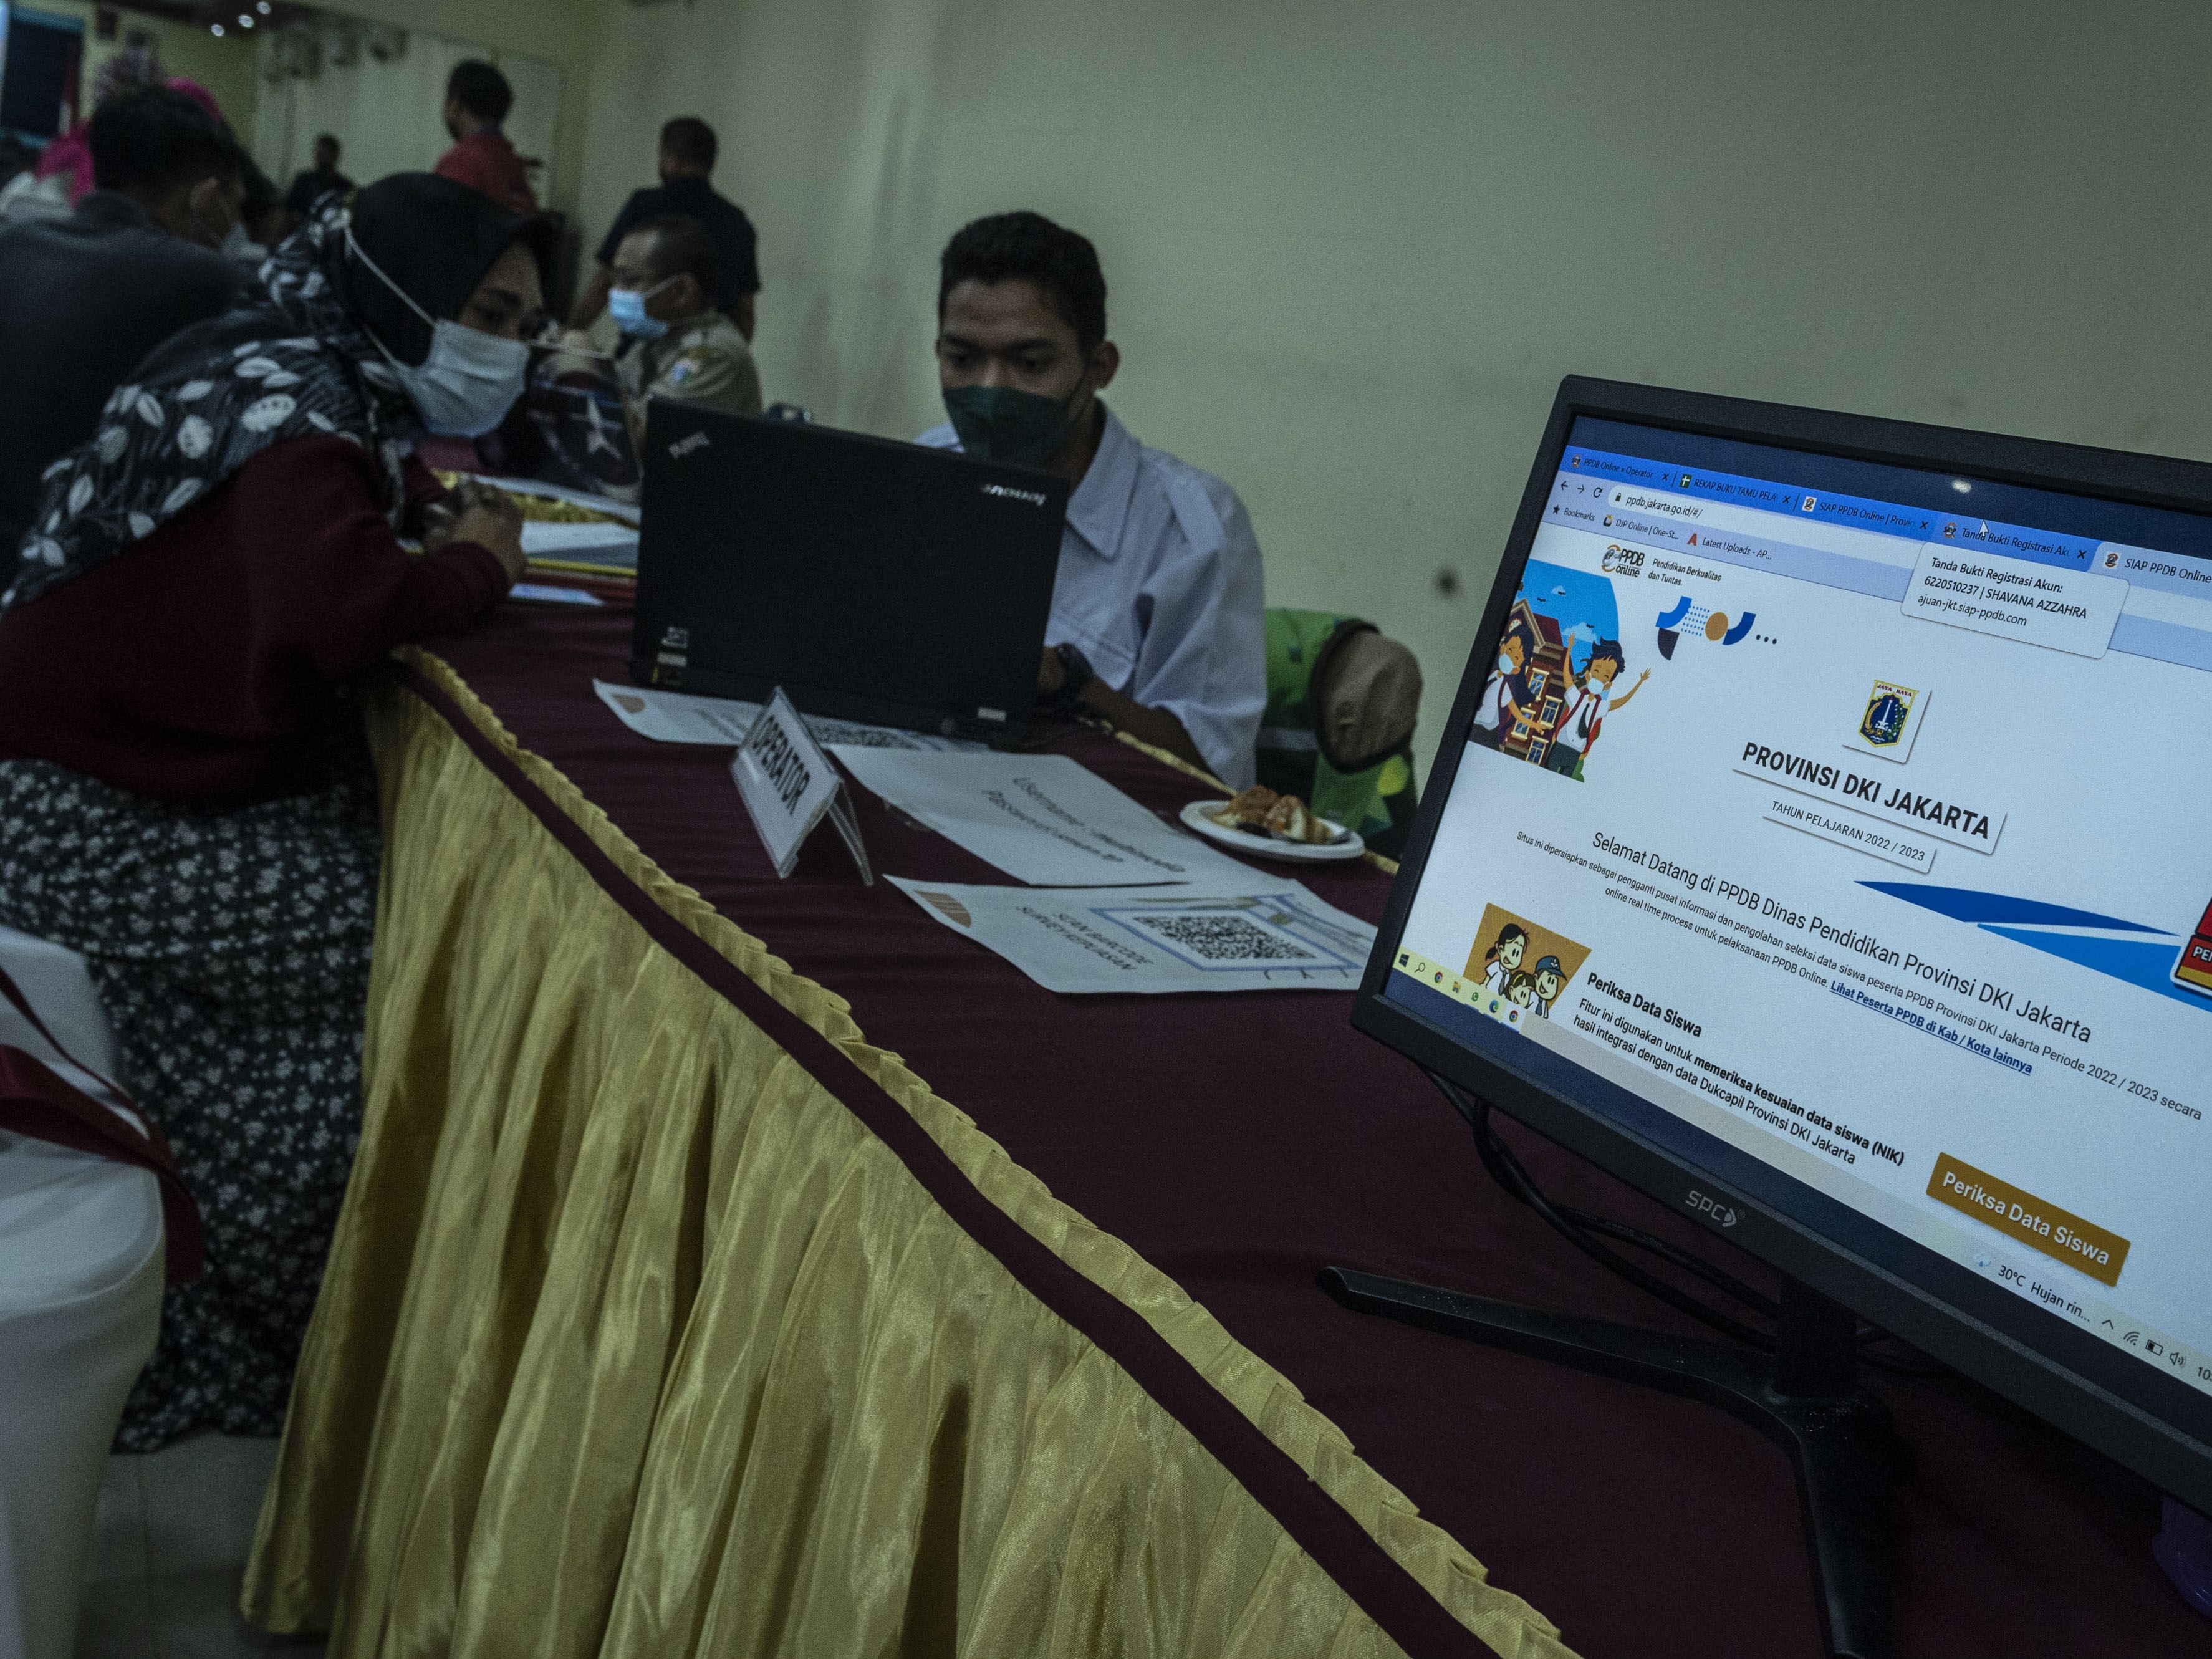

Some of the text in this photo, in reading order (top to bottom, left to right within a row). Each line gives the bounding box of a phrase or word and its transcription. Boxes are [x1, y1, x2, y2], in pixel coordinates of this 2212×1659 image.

[1583, 458, 1600, 469] PPDB
[1600, 461, 1620, 473] Online
[1625, 466, 1654, 479] Operator
[1693, 478, 1779, 502] REKAP BUKU TAMU PELA
[1564, 507, 1595, 522] Bookmarks
[1625, 496, 1703, 519] ppdb.jakarta.go.id/#/
[1819, 501, 1838, 513] SIAP
[1837, 505, 1859, 517] PPDB
[1859, 509, 1885, 522] Online
[1615, 518, 1628, 528] DJP
[1628, 521, 1649, 533] Online
[1652, 526, 1679, 540] One-St...
[1961, 527, 1987, 542] Tanda
[1987, 532, 2011, 546] Bukti
[2011, 537, 2054, 554] Registrasi
[1619, 548, 1645, 567] PPDB
[1702, 537, 1723, 549] Latest
[1723, 541, 1751, 555] Uploads
[1756, 549, 1772, 560] AP...
[1615, 565, 1641, 578] online
[1648, 570, 1683, 587] dan Tuntas.
[1652, 558, 1722, 582] Pendidikan Berkualitas
[1931, 557, 2063, 593] Tanda Bukti Registrasi Akun:
[2124, 558, 2212, 584] SIAP PPDB Online
[1917, 594, 2027, 627] ajuan-jkt.siap-ppdb.com
[1925, 575, 1980, 595] 6220510237
[1985, 589, 2034, 608] SHAVANA
[2036, 599, 2087, 619] AZZAHRA
[751, 715, 810, 815] OPERATOR
[1742, 741, 1988, 839] PROVINSI DKI JAKARTA
[1772, 801, 1805, 820] TAHUN
[1805, 812, 1864, 840] PELAJARAN
[1864, 833, 1891, 850] 2022
[1898, 844, 1925, 862] 2023
[1592, 832, 2092, 1043] Selamat Datang di PPDB Dinas Pendidikan Provinsi DKI Jakarta
[1517, 831, 2202, 1120] Situs ini dipersiapkan sebagai pengganti pusat informasi dan pengolahan seleksi data siswa peserta PPDB Provinsi DKI Jakarta Periode 2022 / 2023 secara
[1605, 888, 2032, 1074] online real time process untuk pelaksanaan PPDB Online. Lihat Peserta PPDB di Kab / Kota lainnya
[1587, 972, 1702, 1038] Periksa Data Siswa
[1573, 1014, 1855, 1165] hasil integrasi dengan data Dukcapil Provinsi DKI Jakarta
[1579, 998, 1905, 1166] Fitur ini digunakan untuk memeriksa kesuaian data siswa (NIK)
[1943, 1171, 2109, 1265] Periksa Data Siswa
[1998, 1265, 2090, 1322] 30°C Hujan rin...
